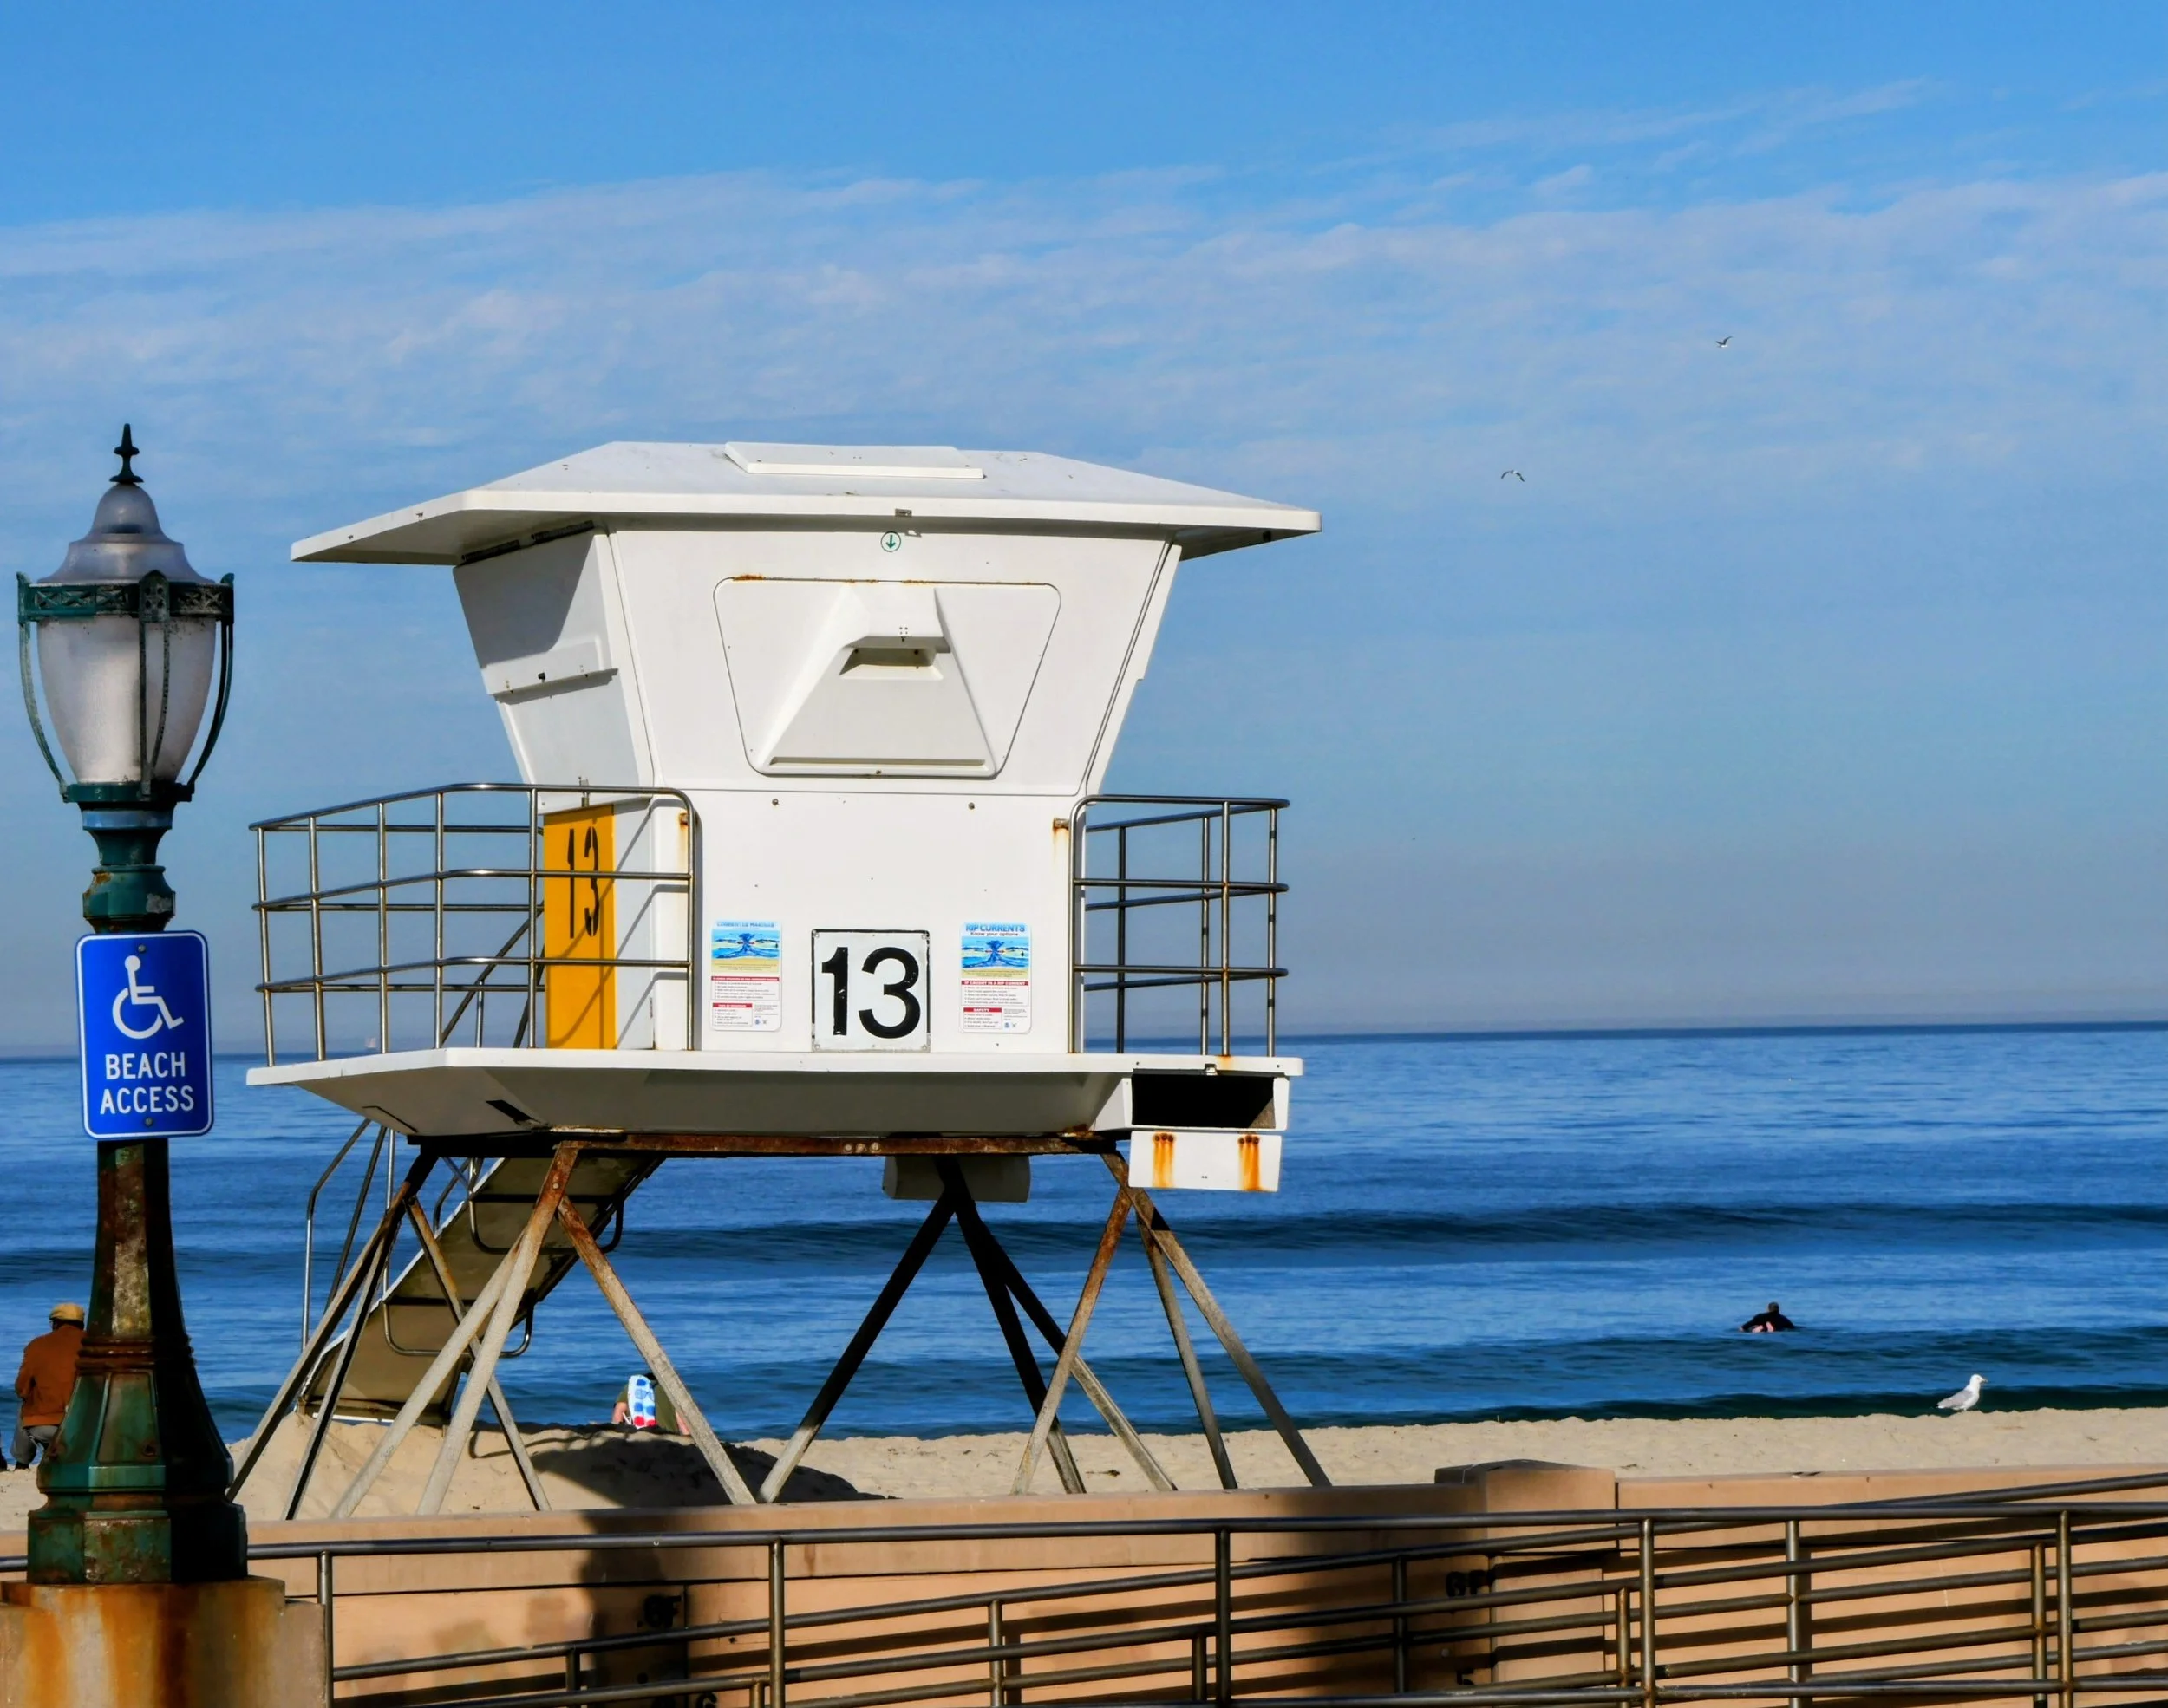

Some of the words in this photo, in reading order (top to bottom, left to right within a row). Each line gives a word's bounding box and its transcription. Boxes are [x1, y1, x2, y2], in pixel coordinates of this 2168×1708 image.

[567, 826, 599, 939] 13
[980, 924, 1026, 933] CURRENTS
[821, 946, 921, 1040] 13
[105, 1052, 186, 1080] BEACH
[100, 1085, 195, 1115] ACCESS
